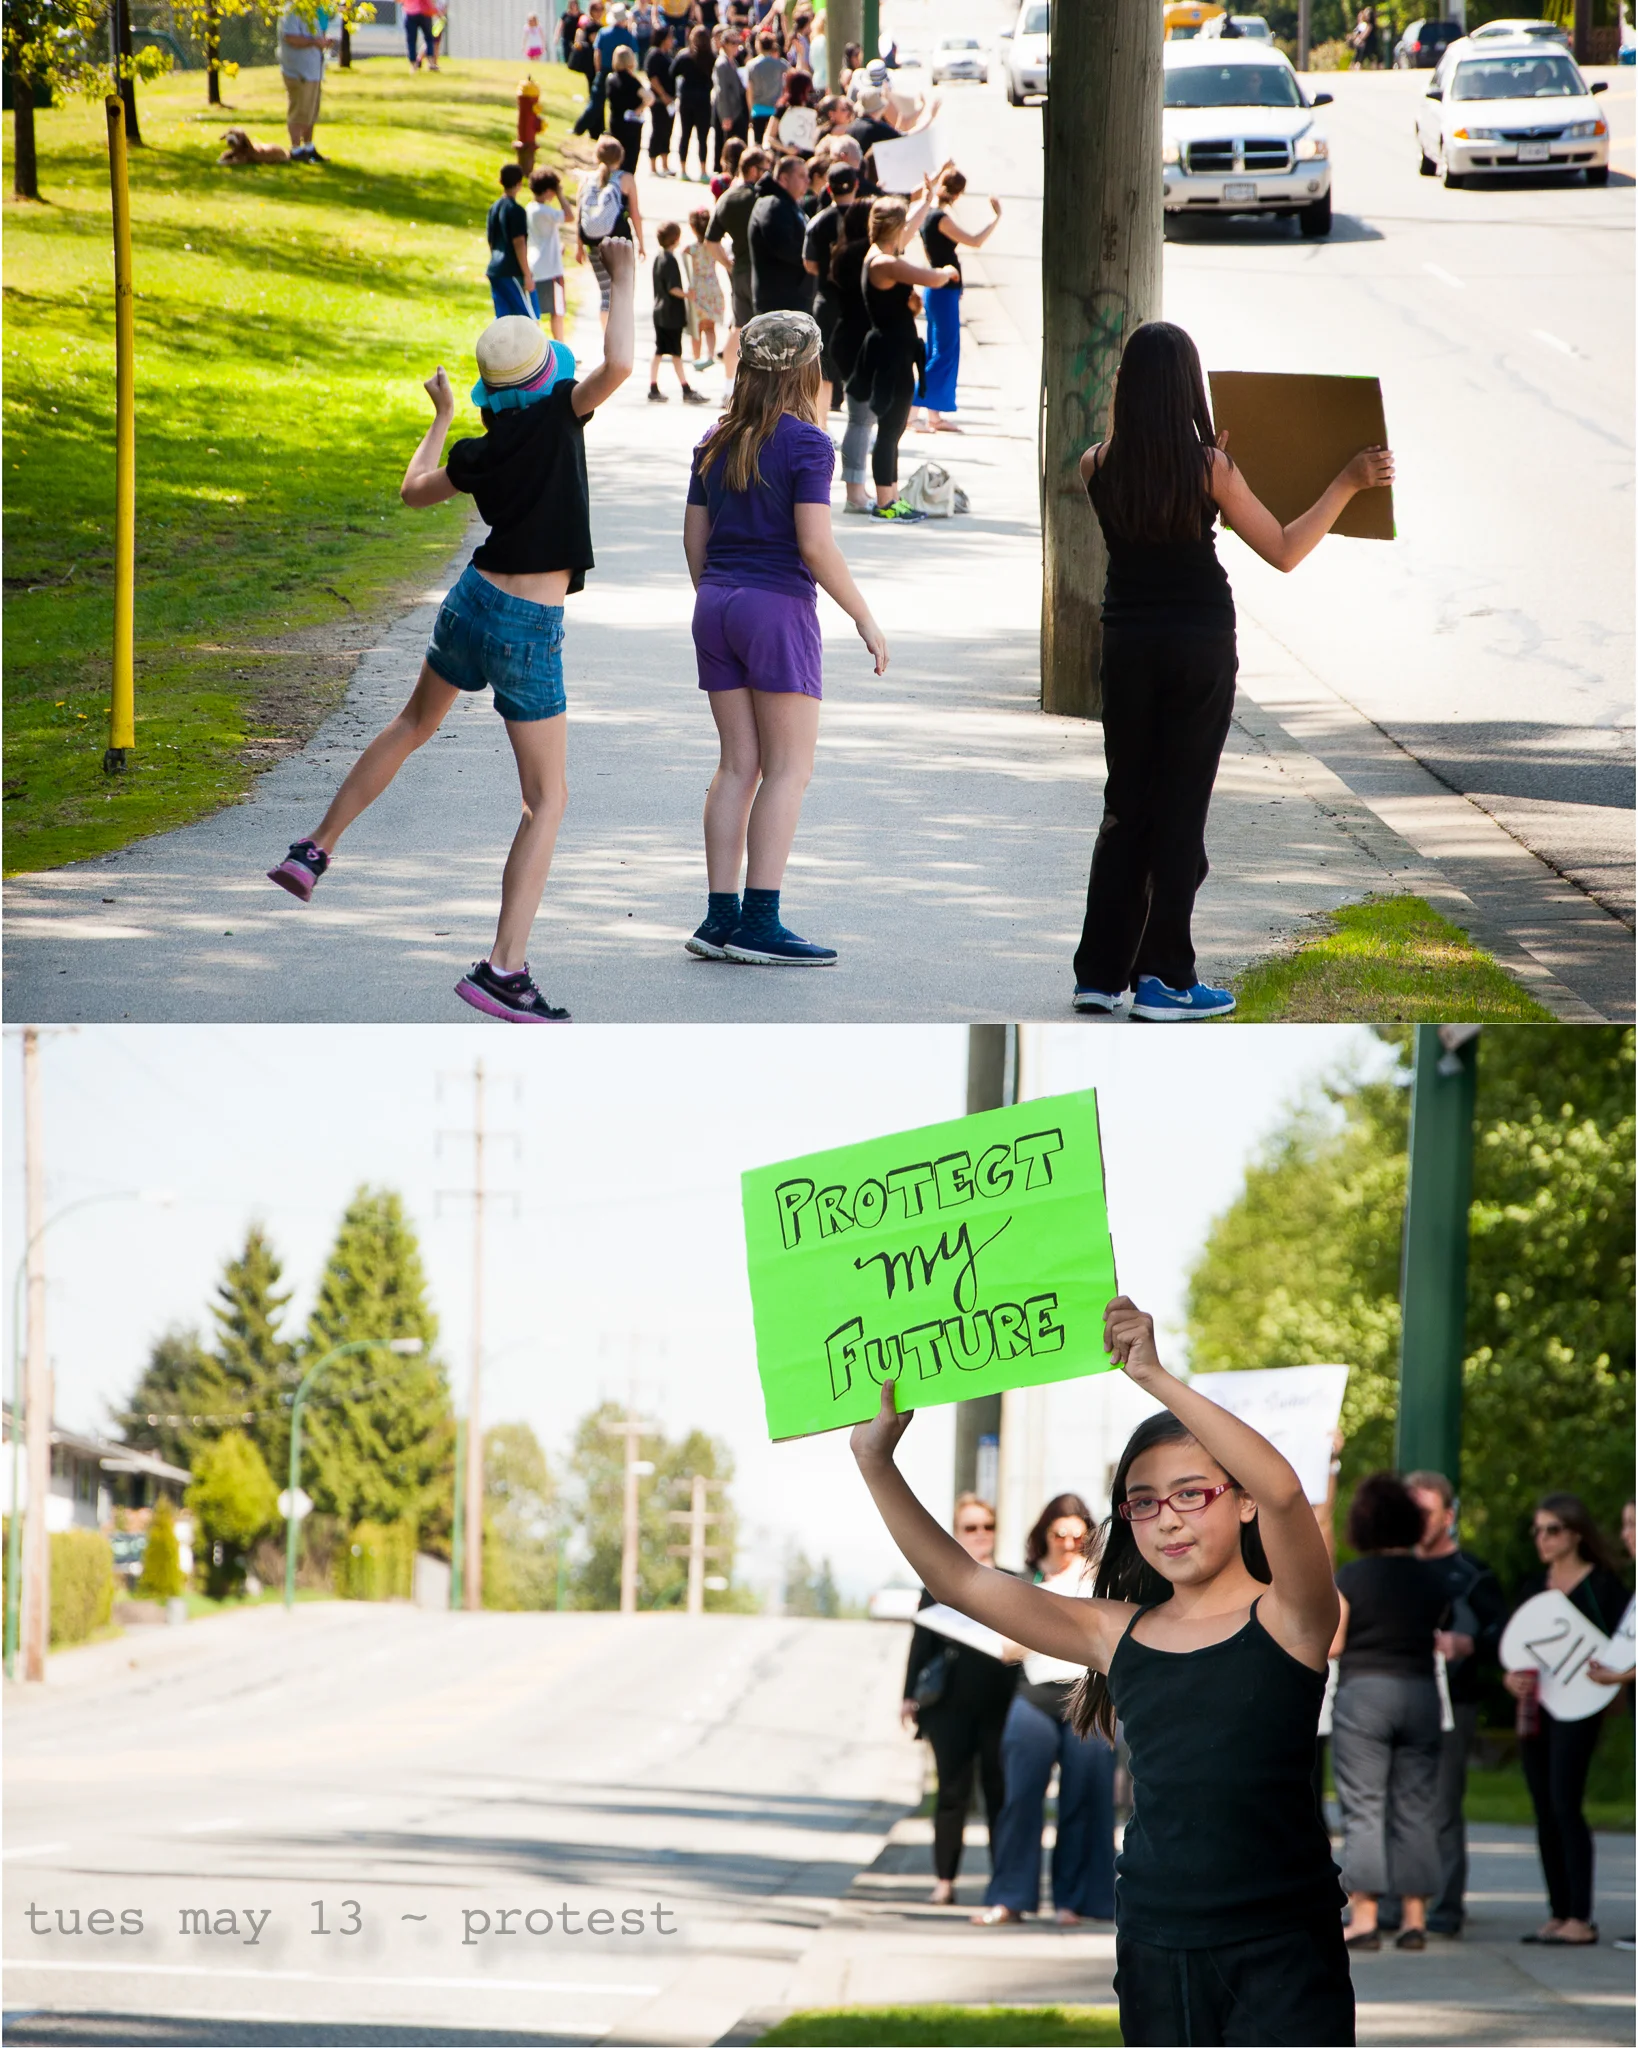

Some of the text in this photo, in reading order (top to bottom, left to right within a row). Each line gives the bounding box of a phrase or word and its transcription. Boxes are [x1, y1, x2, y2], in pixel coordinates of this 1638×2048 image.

[775, 1128, 1064, 1250] PROTECT
[854, 1216, 1012, 1314] my
[824, 1292, 1065, 1401] FUTURE
